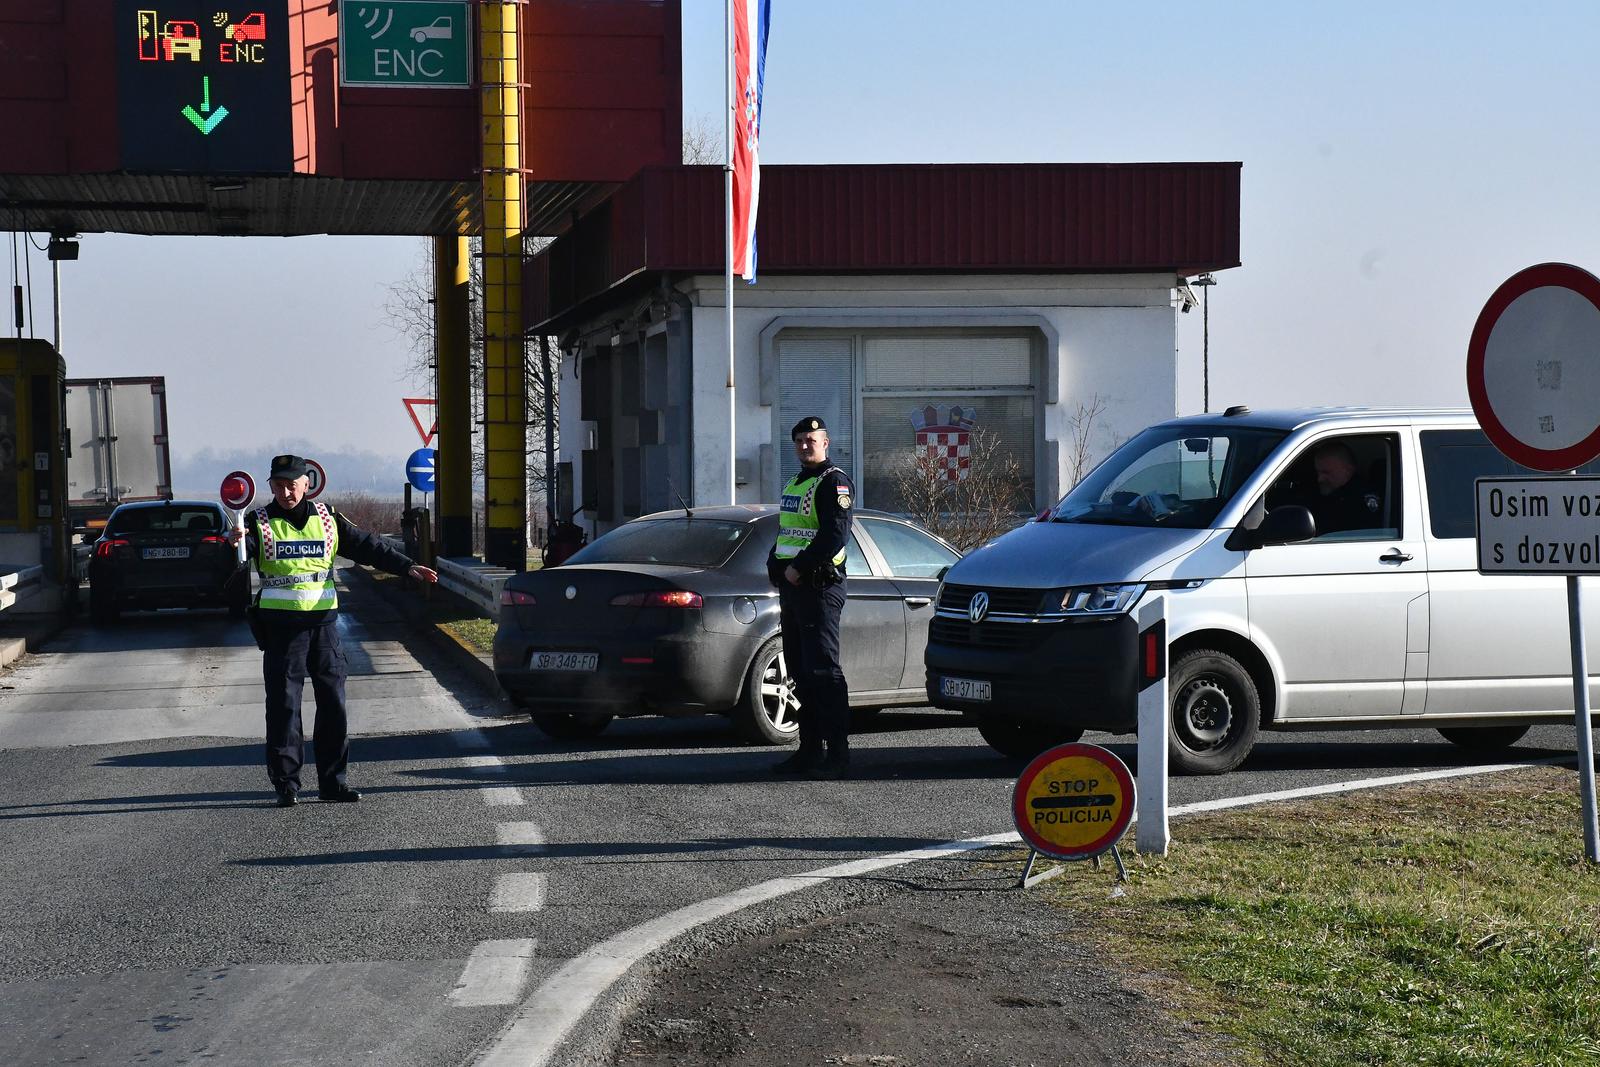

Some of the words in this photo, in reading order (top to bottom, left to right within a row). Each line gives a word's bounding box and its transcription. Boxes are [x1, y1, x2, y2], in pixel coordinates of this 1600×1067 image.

[220, 43, 265, 63] ENC
[374, 49, 445, 77] ENC
[1489, 487, 1549, 518] Osim
[278, 544, 323, 556] POLICIJA
[1493, 542, 1504, 564] s
[1518, 535, 1600, 564] dozvol
[537, 654, 551, 669] SB
[945, 679, 955, 695] SB
[1049, 779, 1099, 794] STOP
[1034, 809, 1113, 825] POLICIJA
